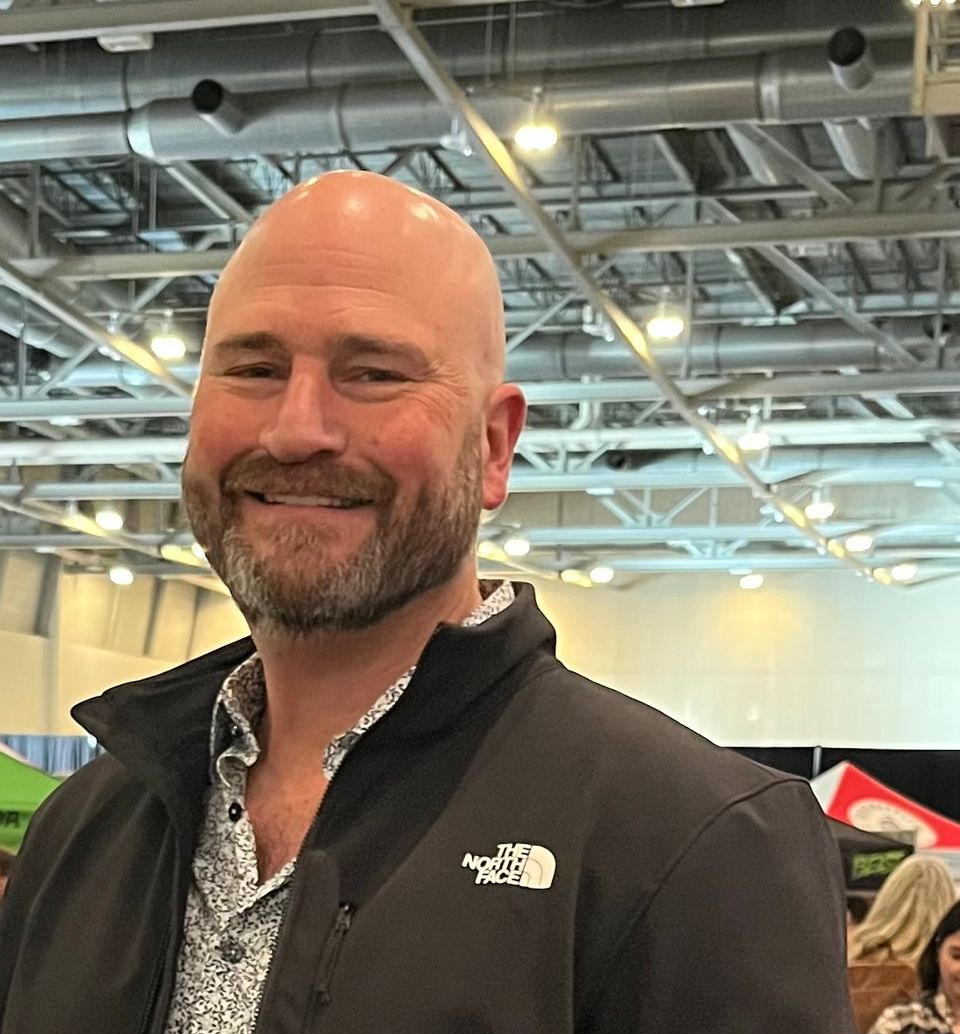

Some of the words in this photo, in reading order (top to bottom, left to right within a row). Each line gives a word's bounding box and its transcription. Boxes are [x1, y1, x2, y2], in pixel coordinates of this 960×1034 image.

[497, 843, 532, 859] THE
[461, 852, 526, 872] NORTH
[474, 869, 522, 885] FACE
